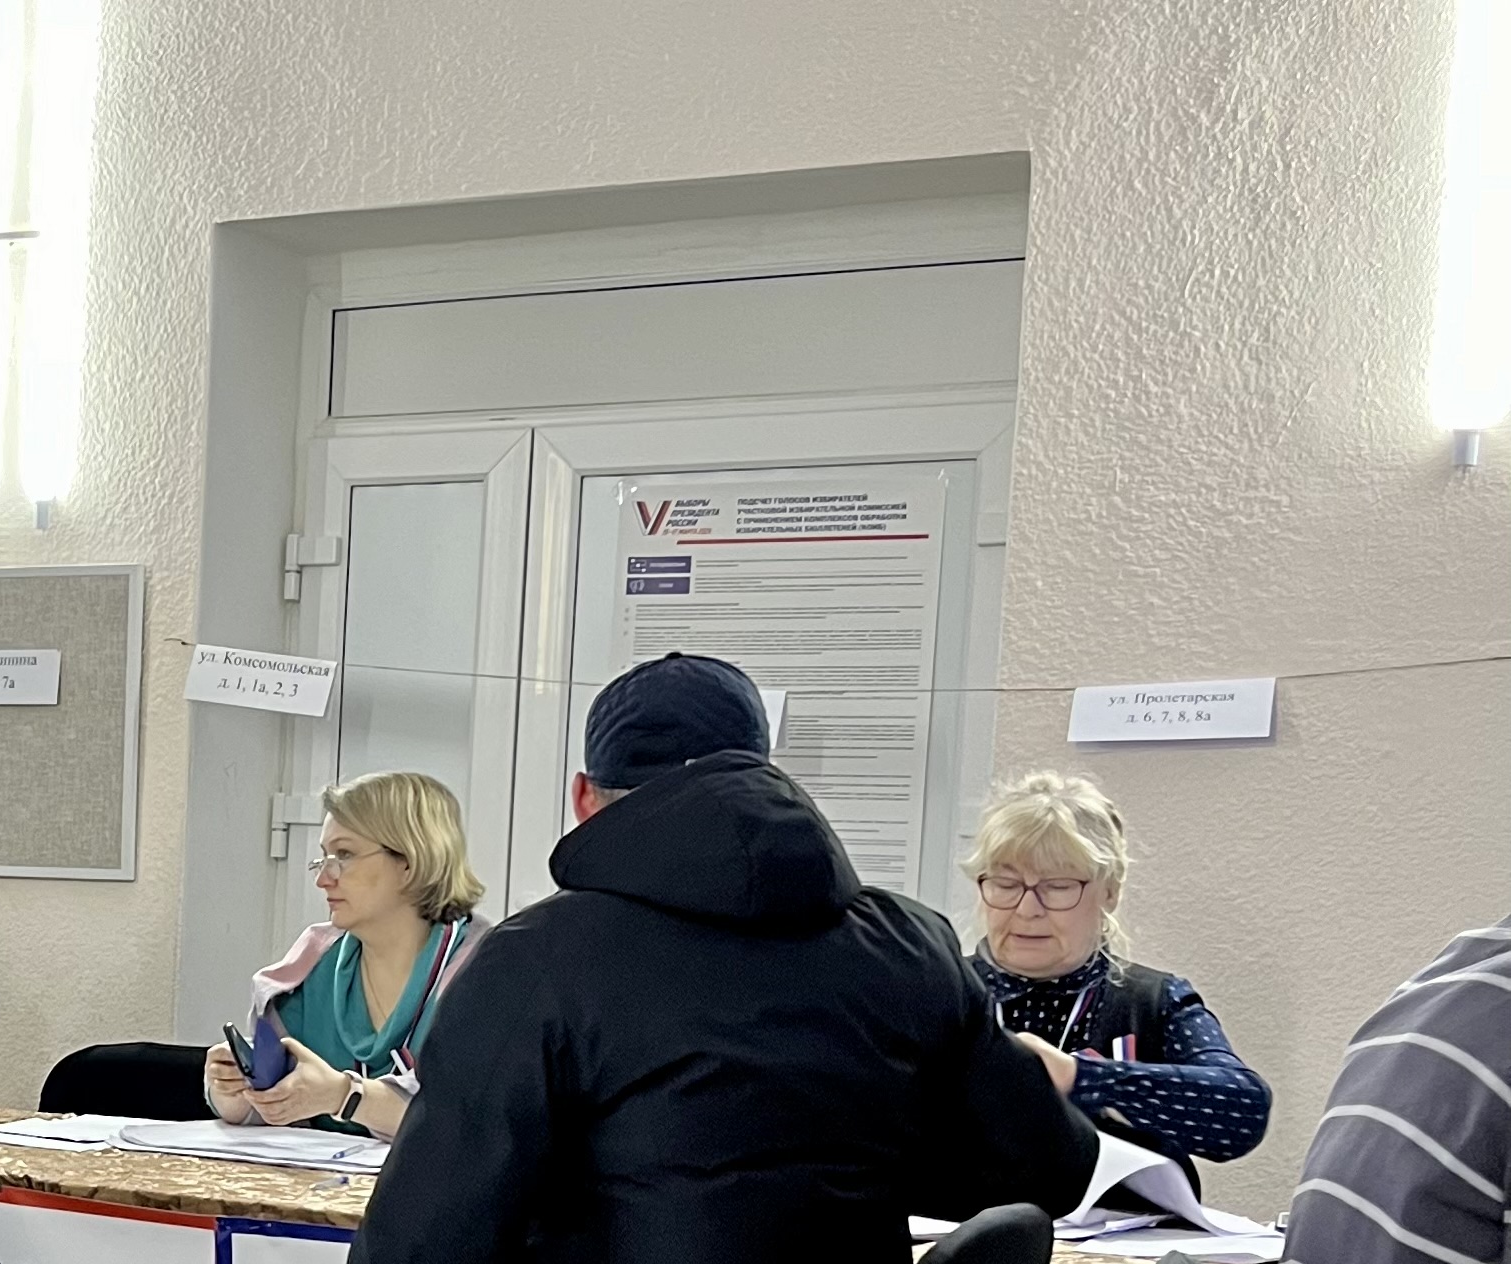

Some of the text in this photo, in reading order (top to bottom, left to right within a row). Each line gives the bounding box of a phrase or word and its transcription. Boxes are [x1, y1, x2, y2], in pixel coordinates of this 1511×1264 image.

[223, 651, 330, 677] Комсомольская
[2, 675, 15, 689] 7а
[289, 683, 299, 697] 3
[1134, 692, 1235, 706] Пролетарская
[1194, 710, 1211, 722] 8а
